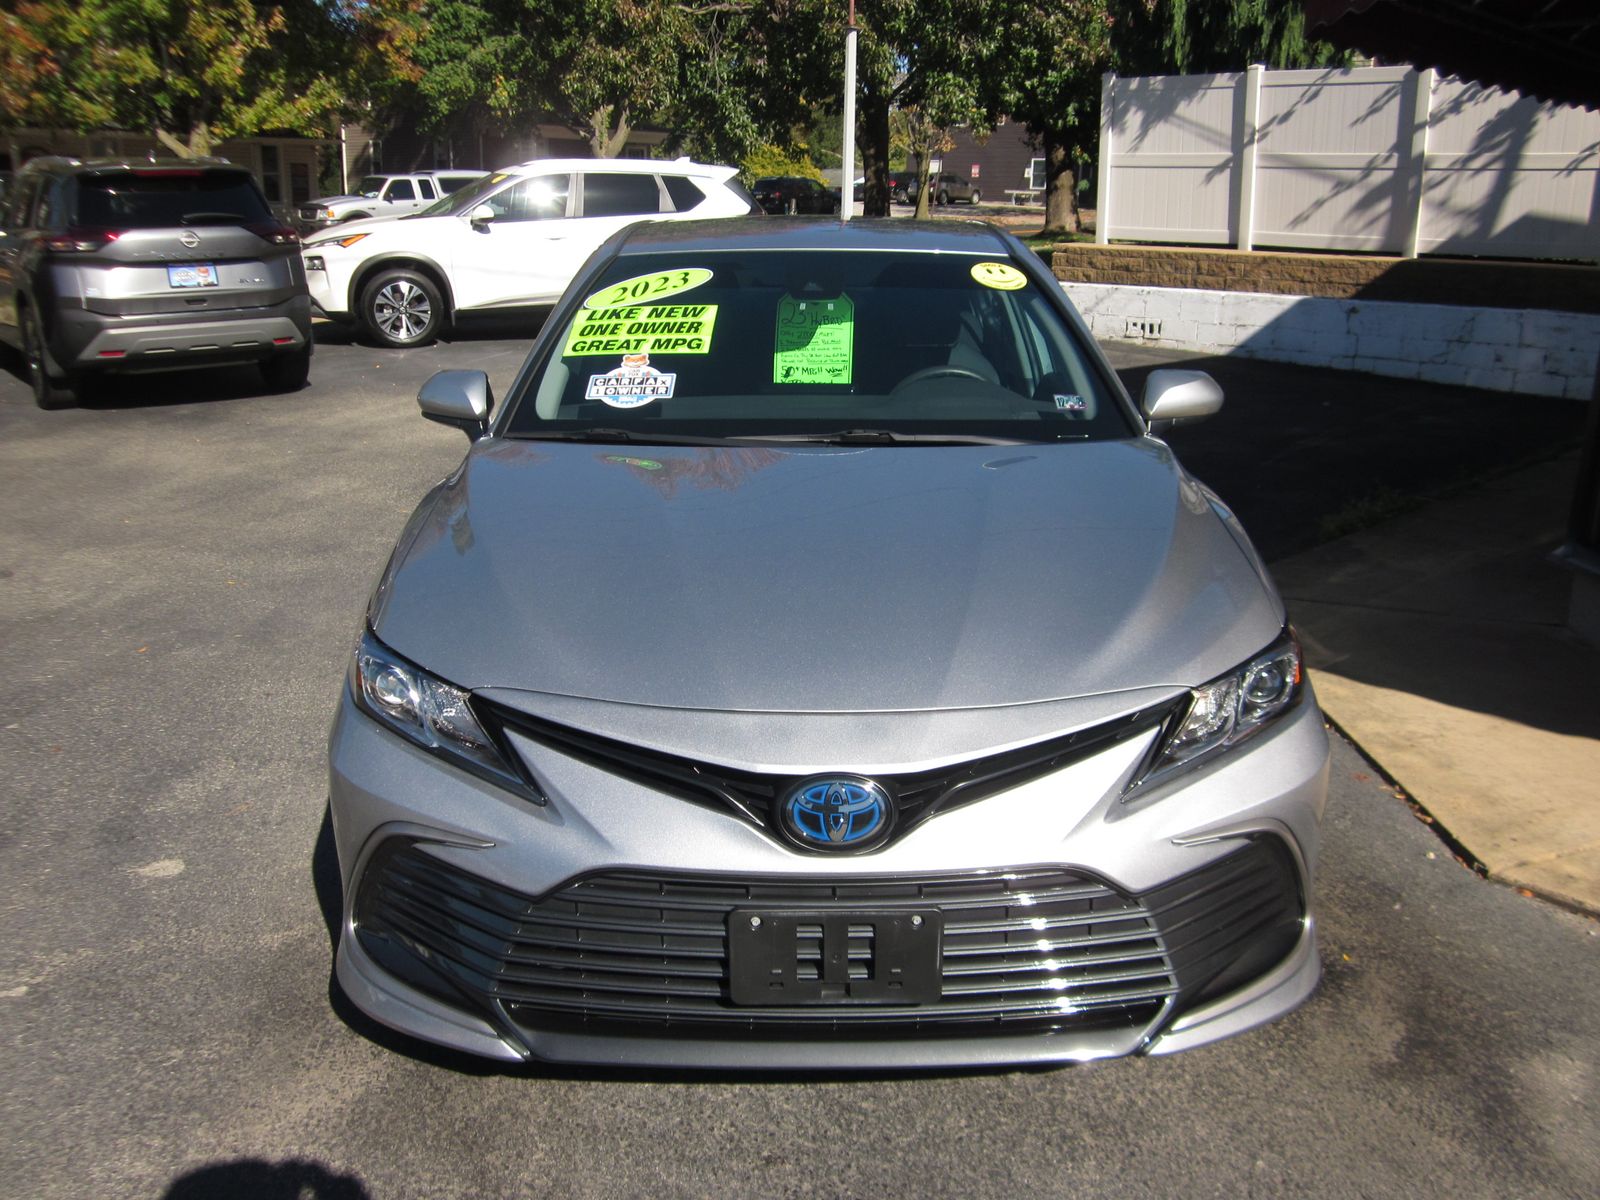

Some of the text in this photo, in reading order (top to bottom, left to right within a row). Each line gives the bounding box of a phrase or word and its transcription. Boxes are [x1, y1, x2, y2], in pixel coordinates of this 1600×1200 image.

[611, 272, 689, 304] 2023
[586, 306, 707, 321] LIKE NEW
[579, 321, 703, 336] ONE OWNER
[571, 337, 703, 352] GREAT MPG
[594, 376, 668, 387] CARFAX
[595, 386, 668, 395] 1 OWNER
